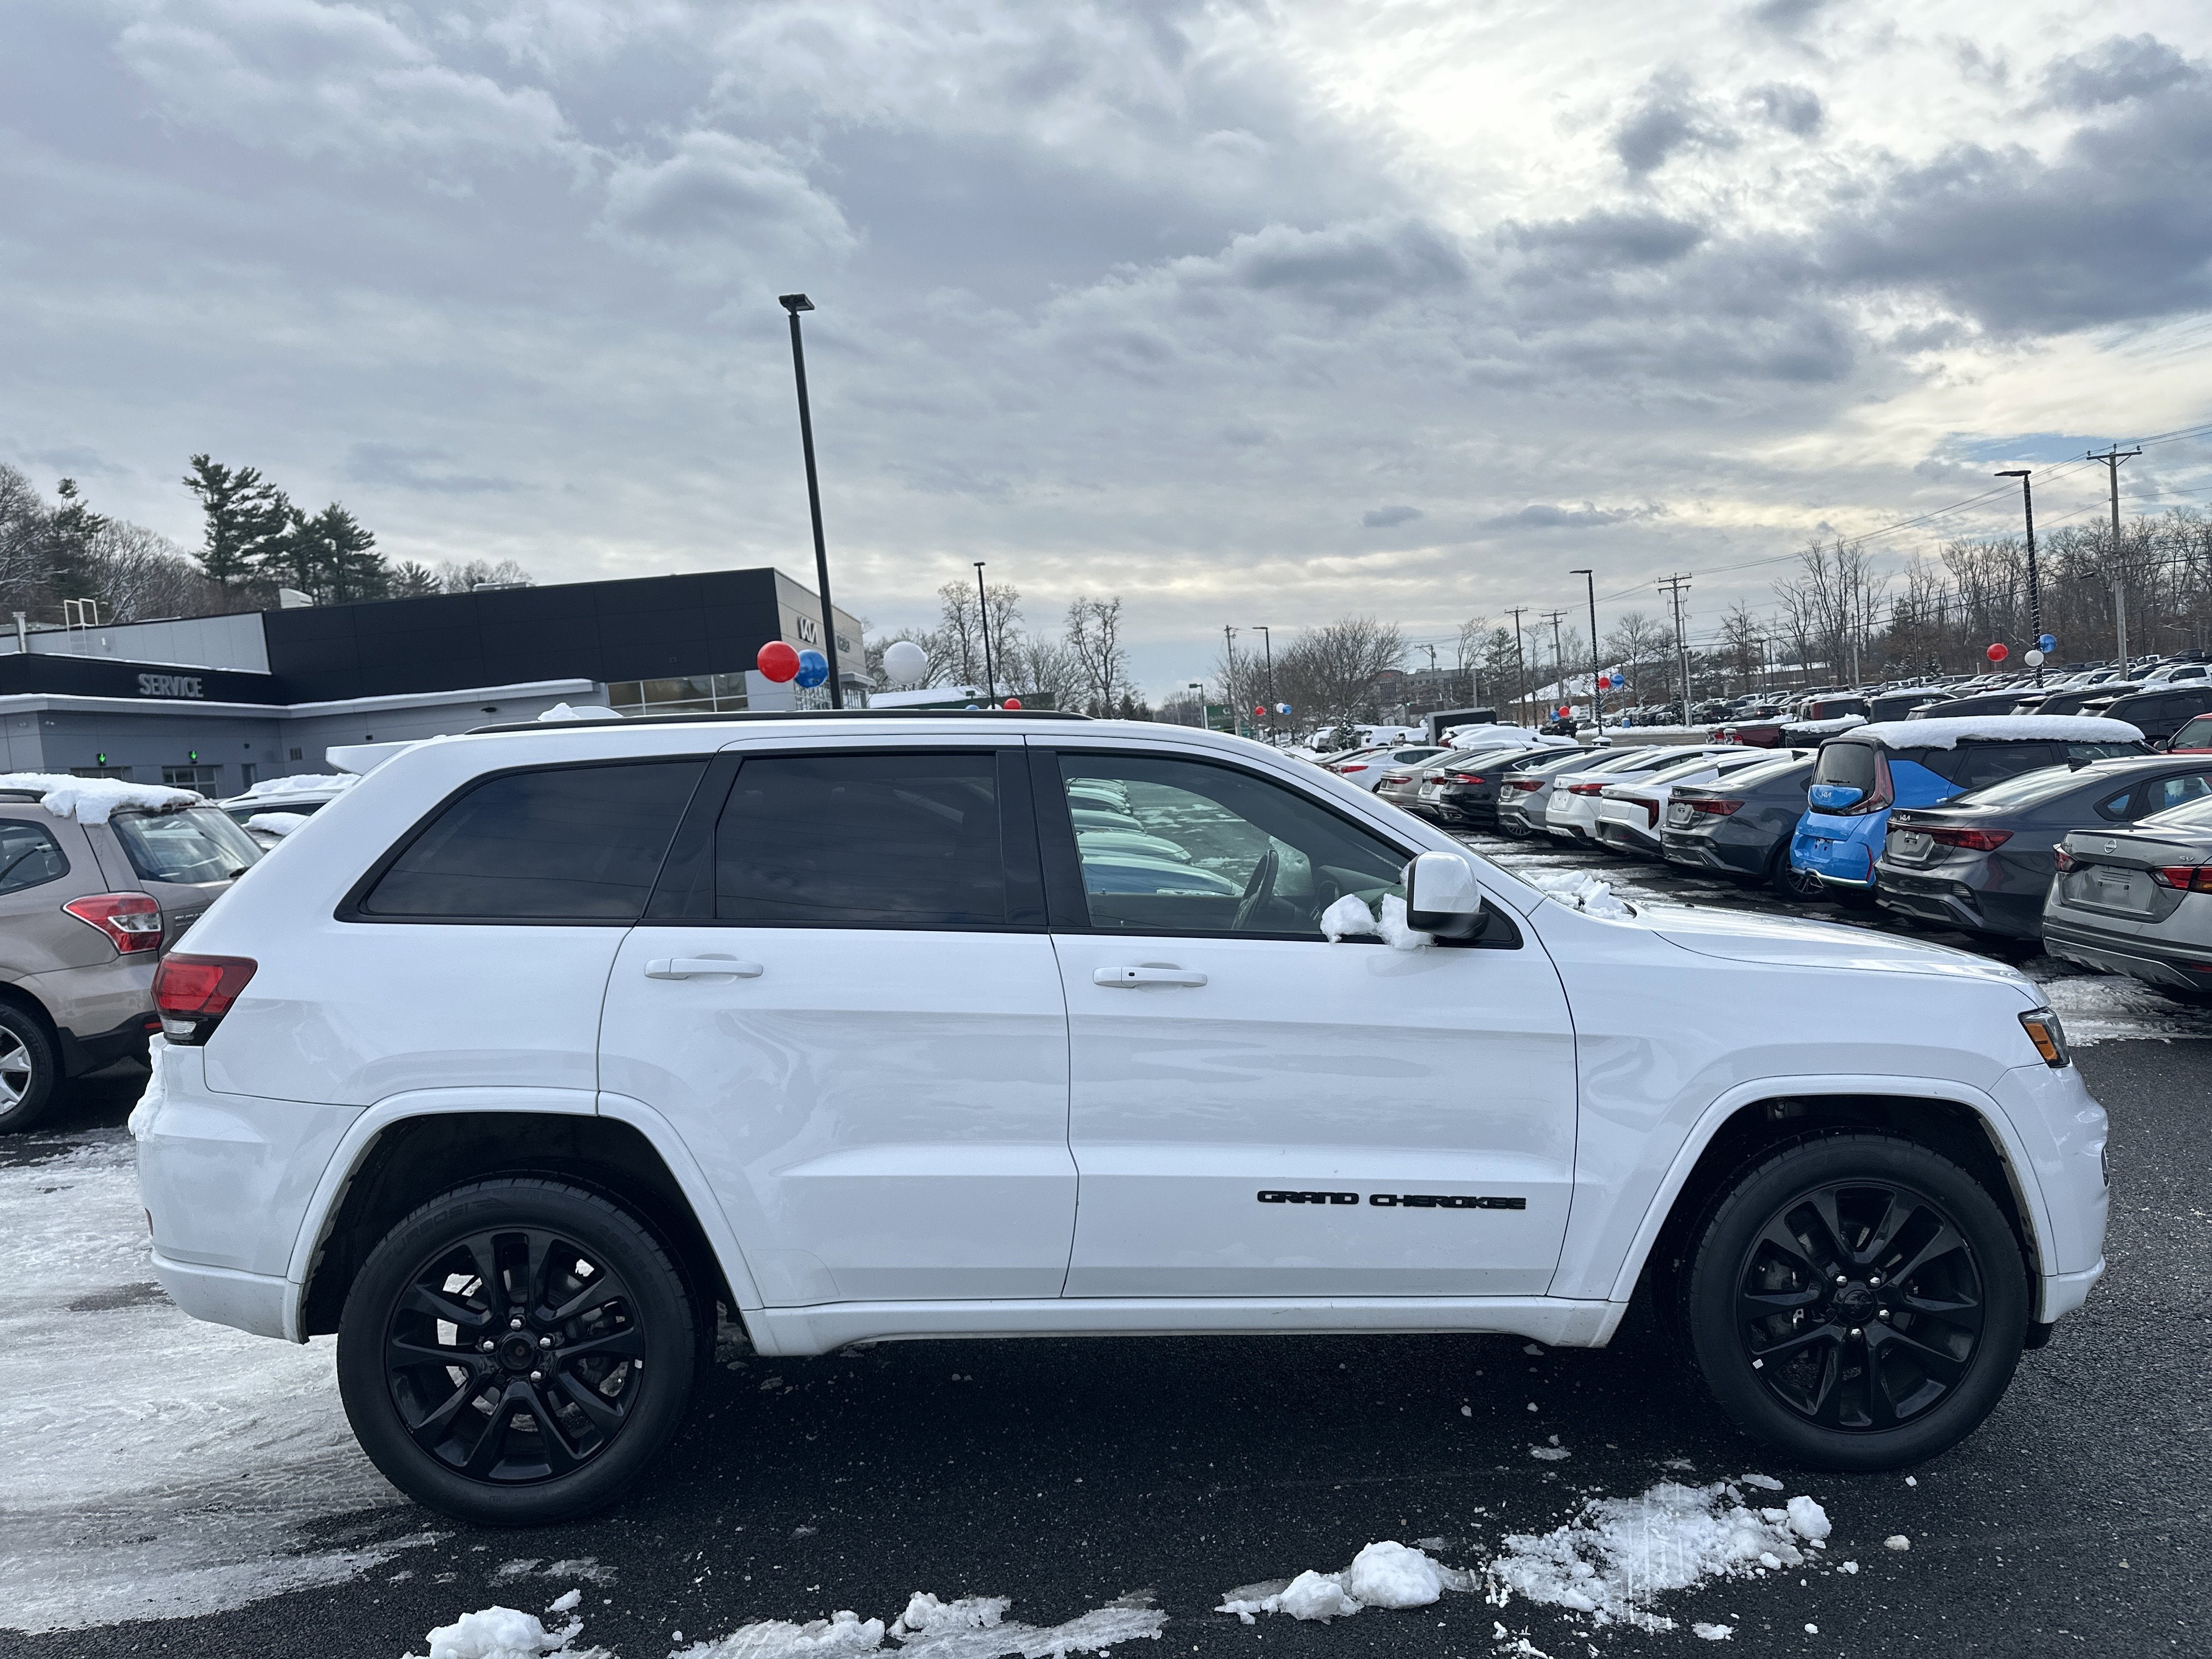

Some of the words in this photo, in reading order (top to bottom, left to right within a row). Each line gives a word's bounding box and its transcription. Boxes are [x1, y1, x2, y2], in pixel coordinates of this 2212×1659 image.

[138, 673, 204, 698] SERVICE
[1257, 1190, 1359, 1204] GRAND
[1369, 1194, 1527, 1209] CHEROKEE
